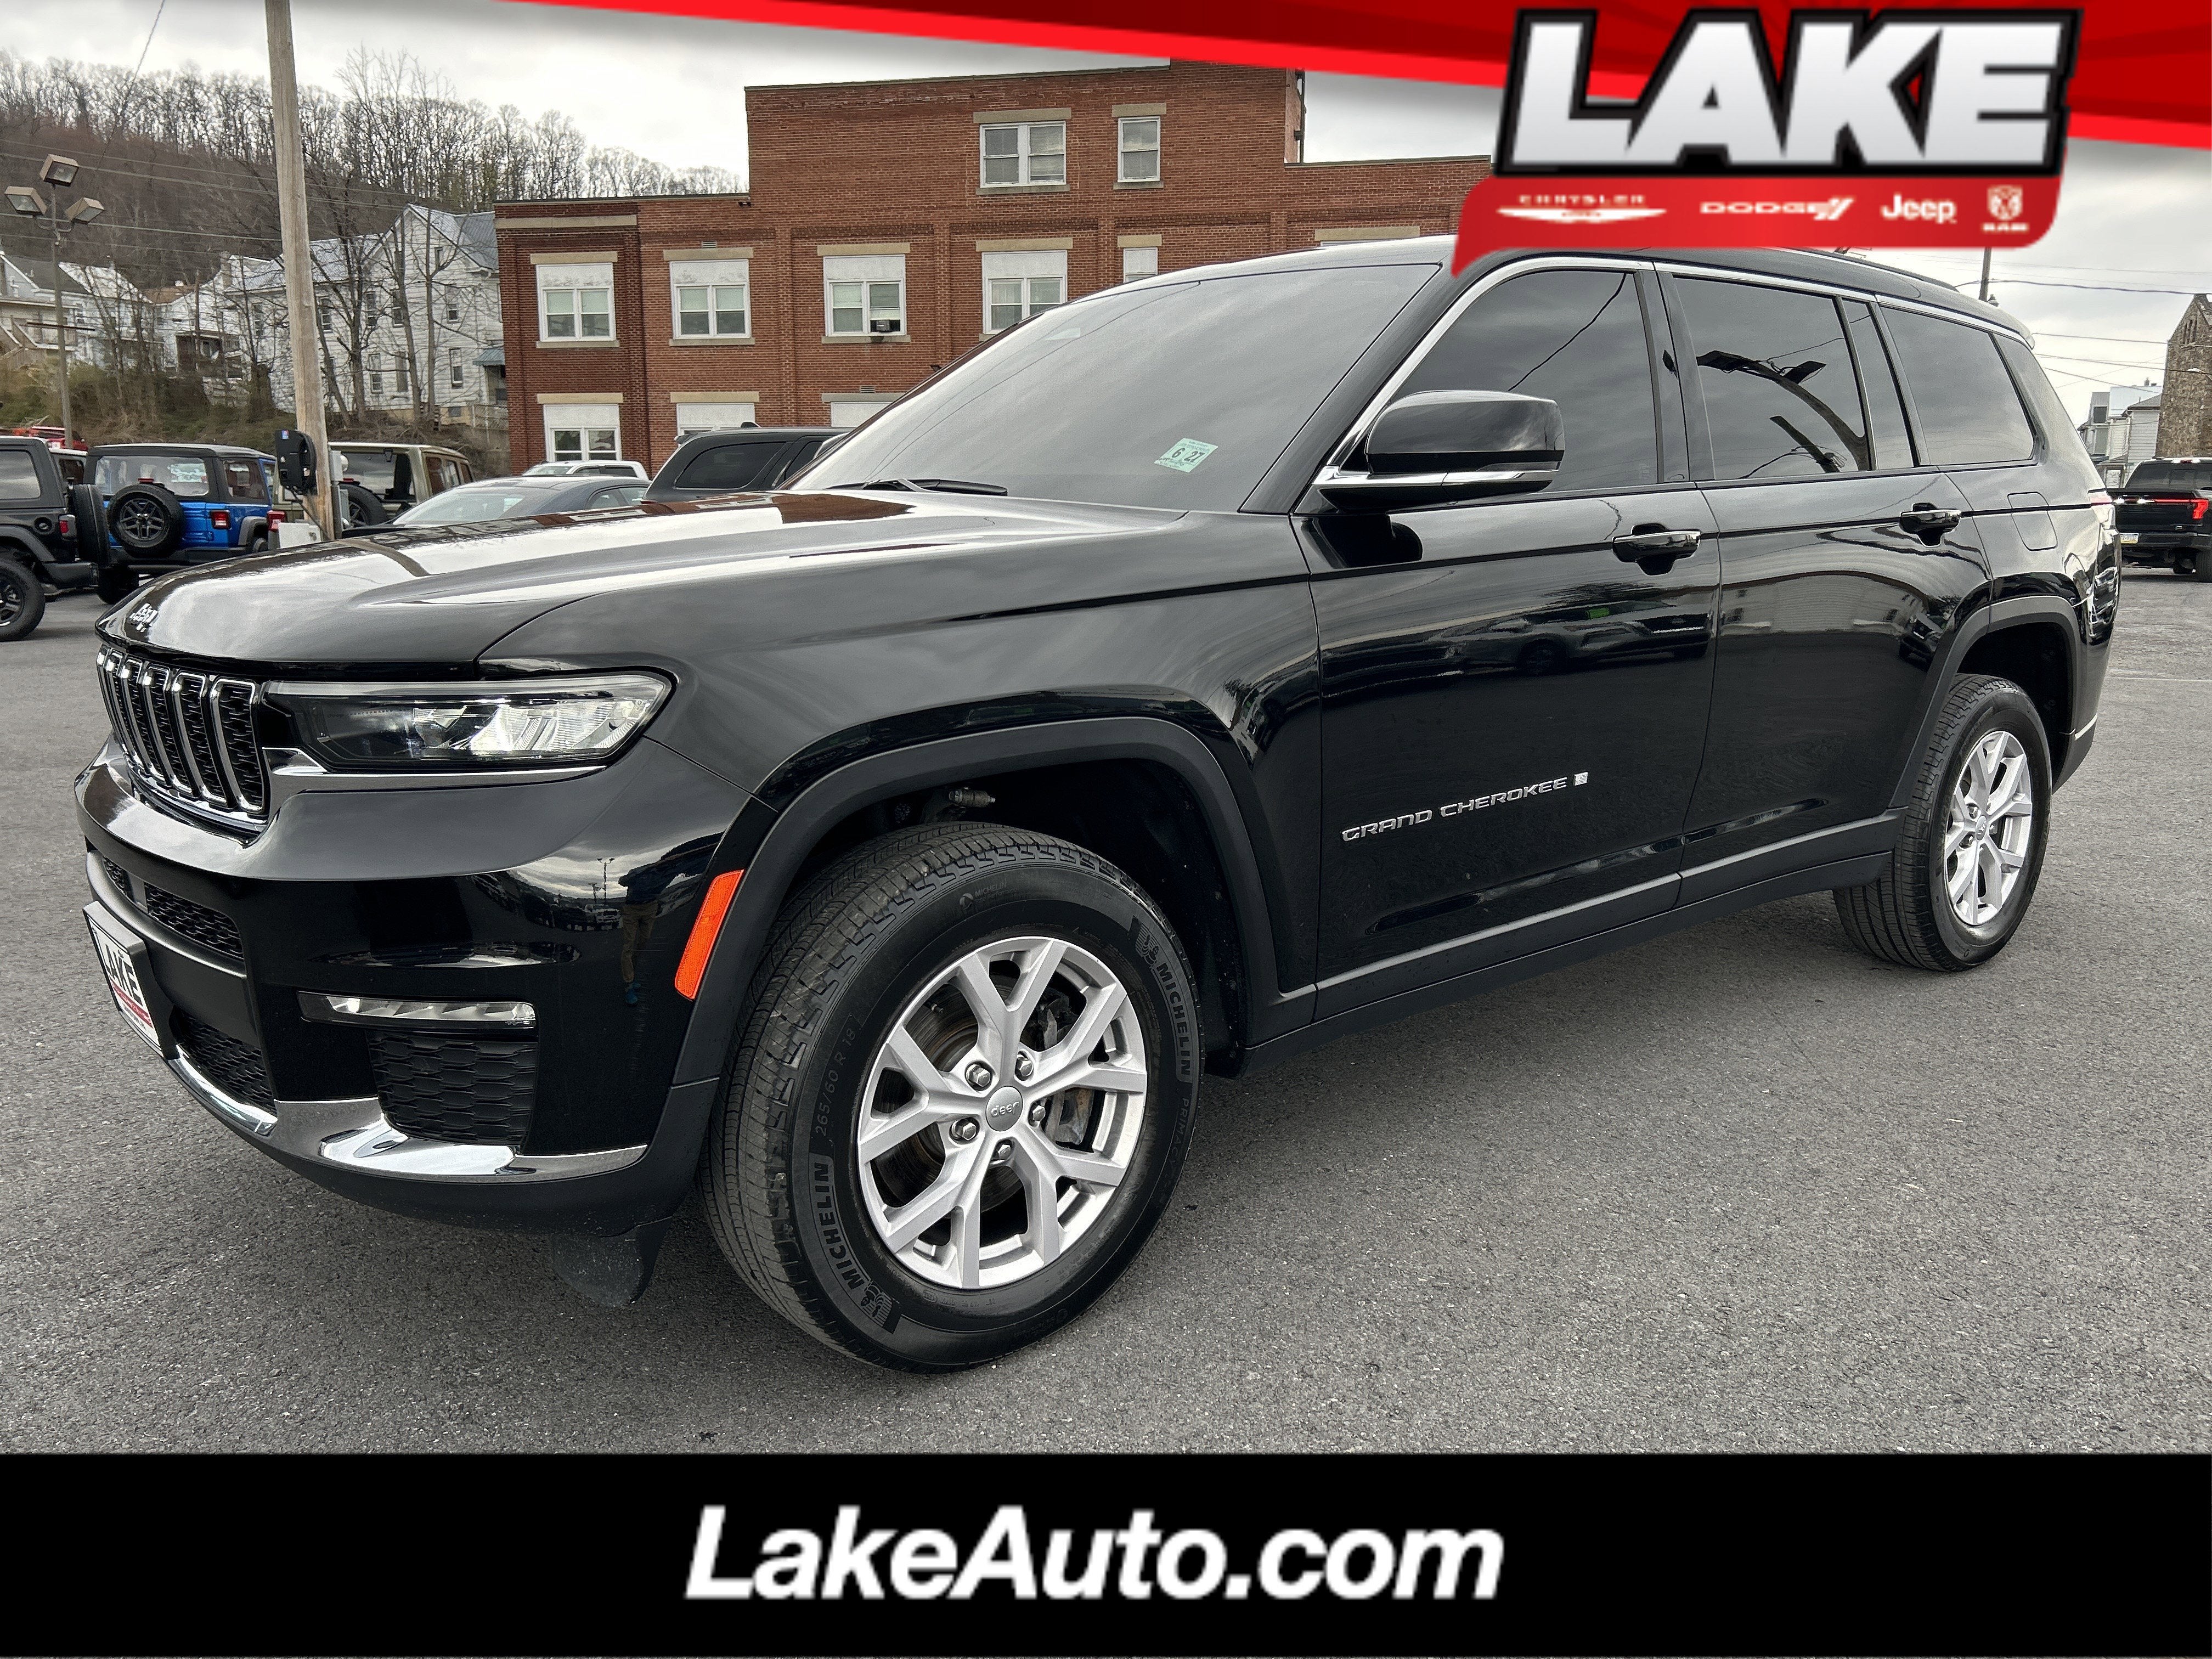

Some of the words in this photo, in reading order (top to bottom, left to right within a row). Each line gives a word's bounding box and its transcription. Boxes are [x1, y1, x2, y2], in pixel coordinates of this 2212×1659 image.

[1171, 447, 1186, 459] 6
[1183, 450, 1205, 463] 27
[1341, 809, 1433, 842] GRAND
[1440, 777, 1567, 817] CHEROKEE
[974, 878, 1007, 898] MICHELIN
[1156, 962, 1191, 1076] MICHELIN
[815, 1070, 839, 1137] 265/60
[833, 1051, 847, 1066] R
[841, 1028, 856, 1047] 18
[991, 1101, 1019, 1117] Jeep
[814, 1162, 865, 1290] MICHELIN
